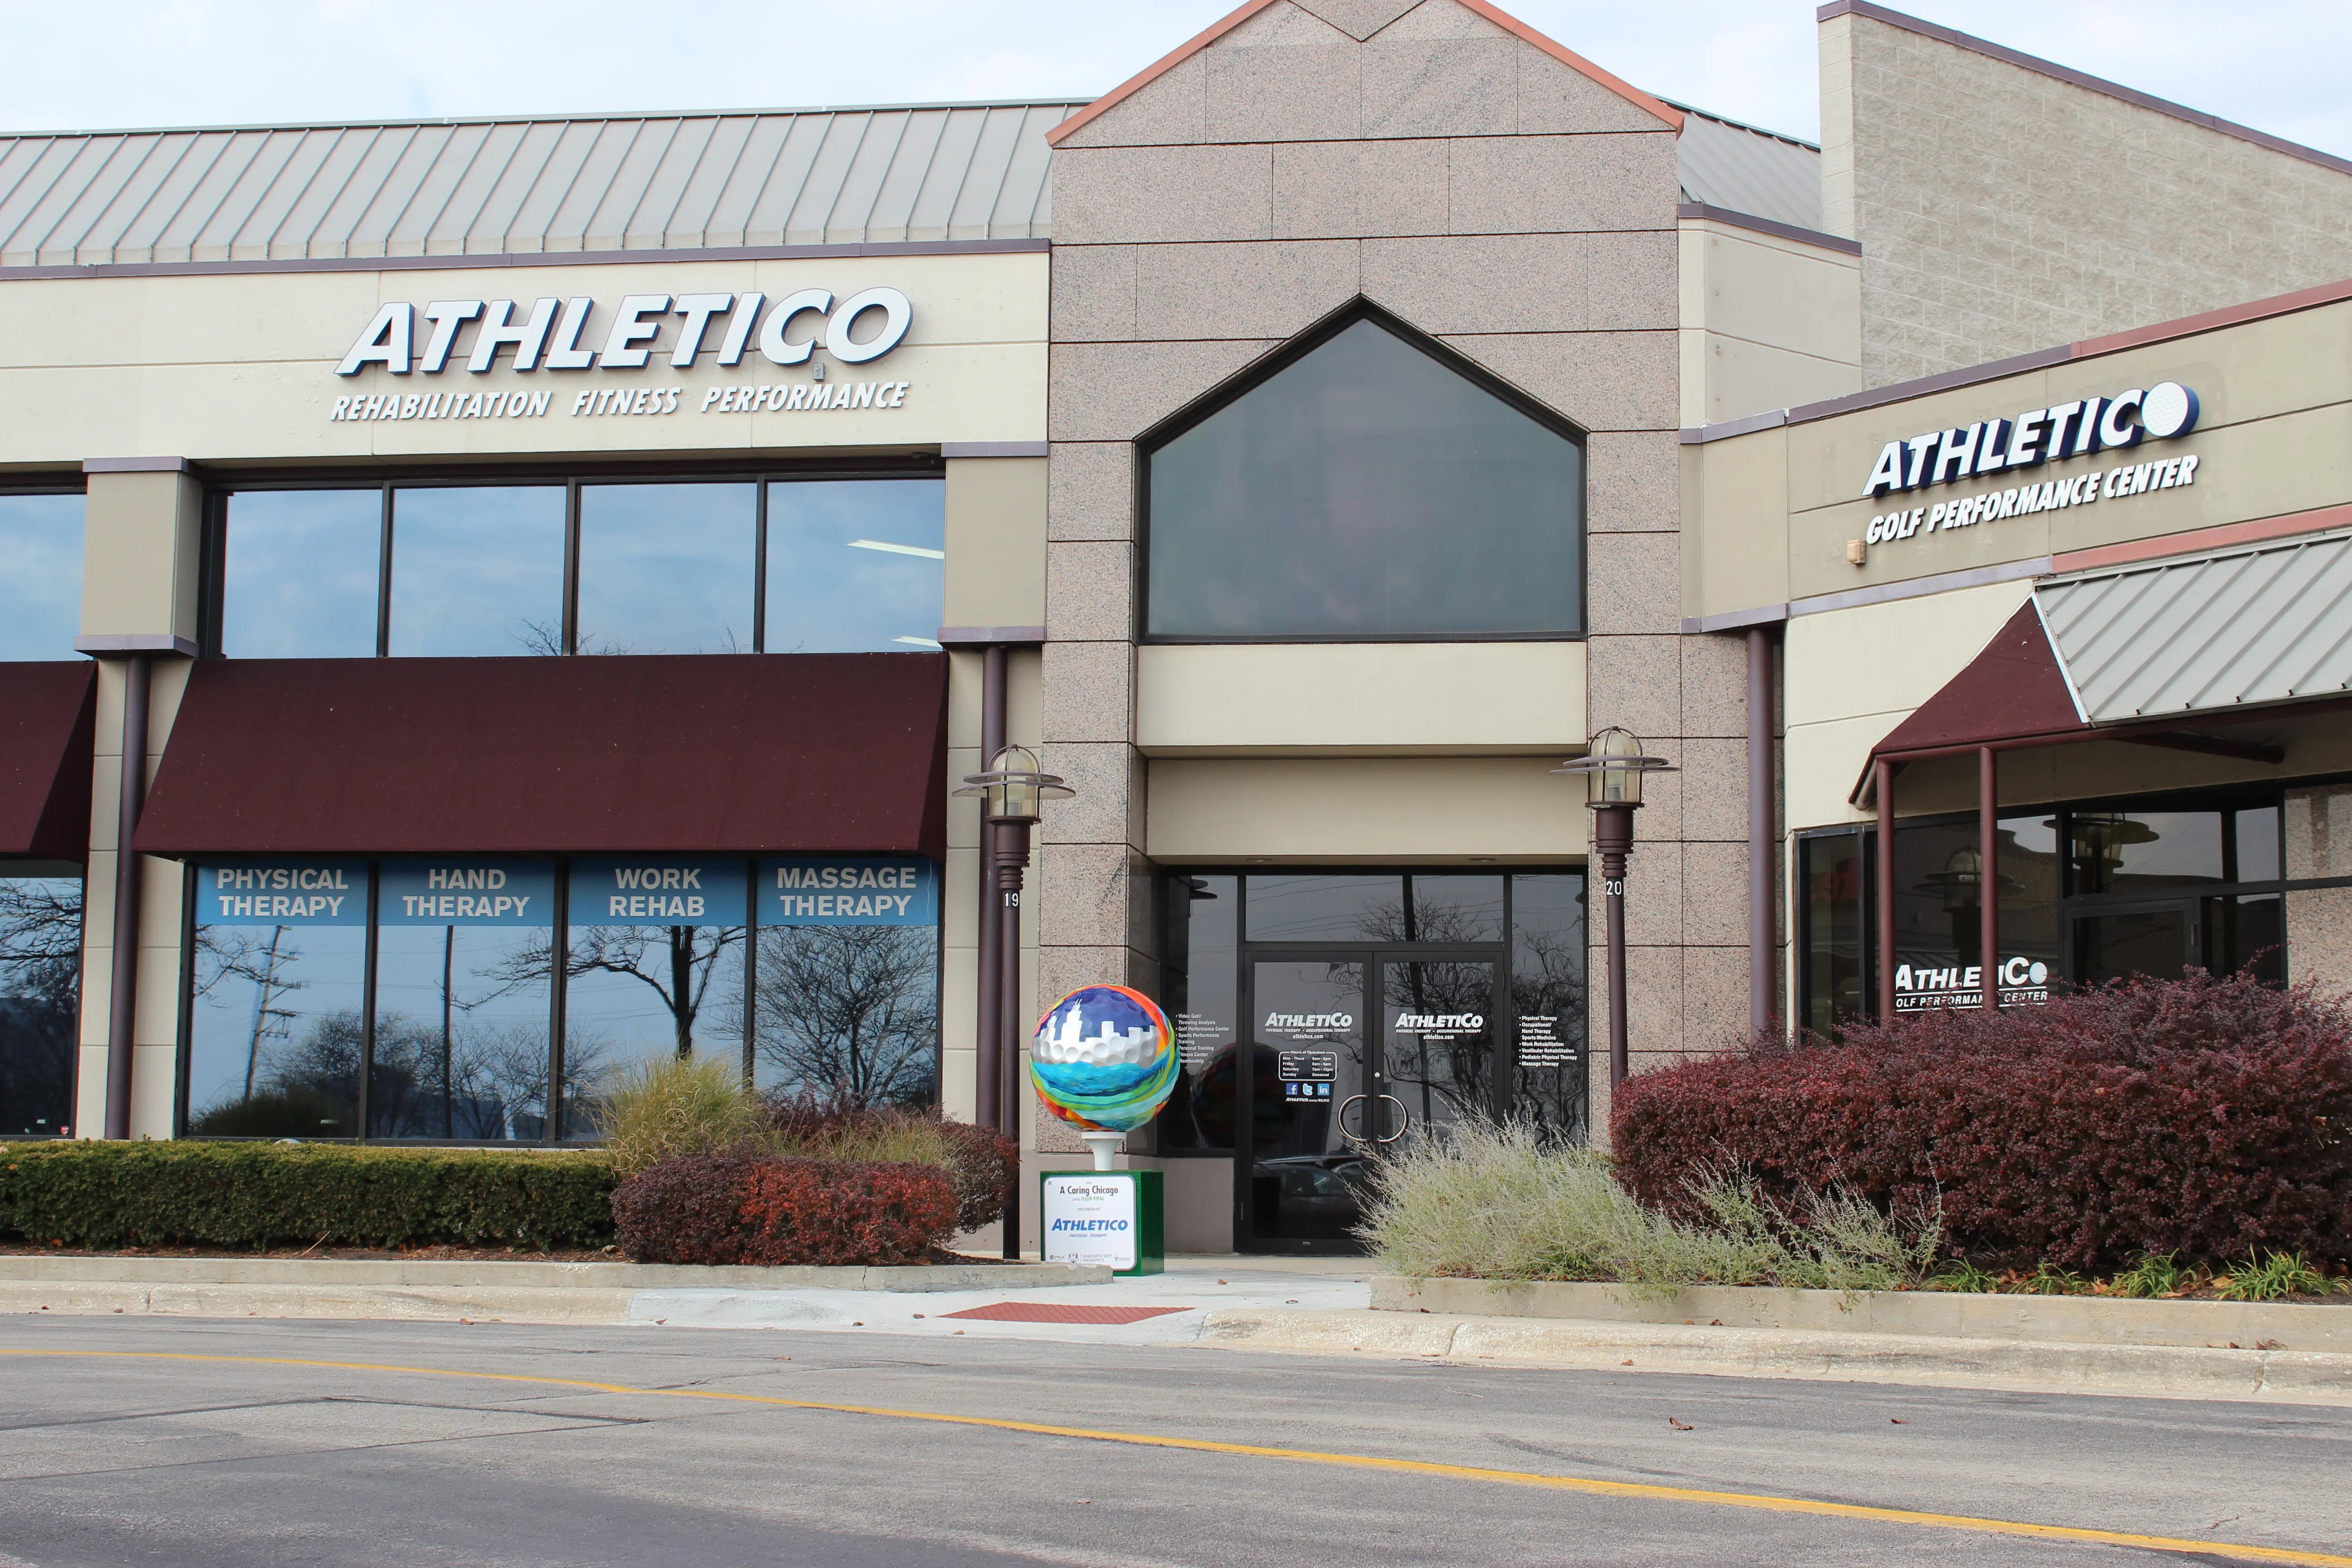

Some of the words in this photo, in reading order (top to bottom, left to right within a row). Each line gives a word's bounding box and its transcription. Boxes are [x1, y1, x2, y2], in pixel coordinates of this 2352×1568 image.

[333, 286, 913, 376] ATHLETICO
[330, 391, 552, 421] REHABILITATION
[571, 387, 681, 416] FITNESS
[700, 382, 910, 413] PERFORMANCE
[1866, 507, 1926, 544] GOLF
[1926, 472, 2103, 532] PERFORMANCE
[2104, 455, 2200, 499] CENTER
[217, 868, 348, 890] PHYSICAL
[428, 869, 506, 890] HAND
[615, 868, 701, 889] WORK
[777, 867, 916, 889] MASSAGE
[1607, 881, 1622, 895] 20
[219, 896, 345, 917] THERAPY
[402, 896, 530, 917] THERAPY
[609, 896, 705, 917] REHAB
[780, 895, 912, 916] THERAPY
[1005, 893, 1019, 906] 19
[1896, 956, 2048, 990] ATHLEICO
[1896, 997, 1916, 1008] OLF
[1920, 994, 1983, 1006] PERFORMAN
[2004, 991, 2048, 1002] CENTER
[1060, 1186, 1065, 1194] A
[1068, 1186, 1089, 1196] Caring
[1092, 1185, 1118, 1196] Chicago
[1051, 1218, 1128, 1231] ATHLETICO
